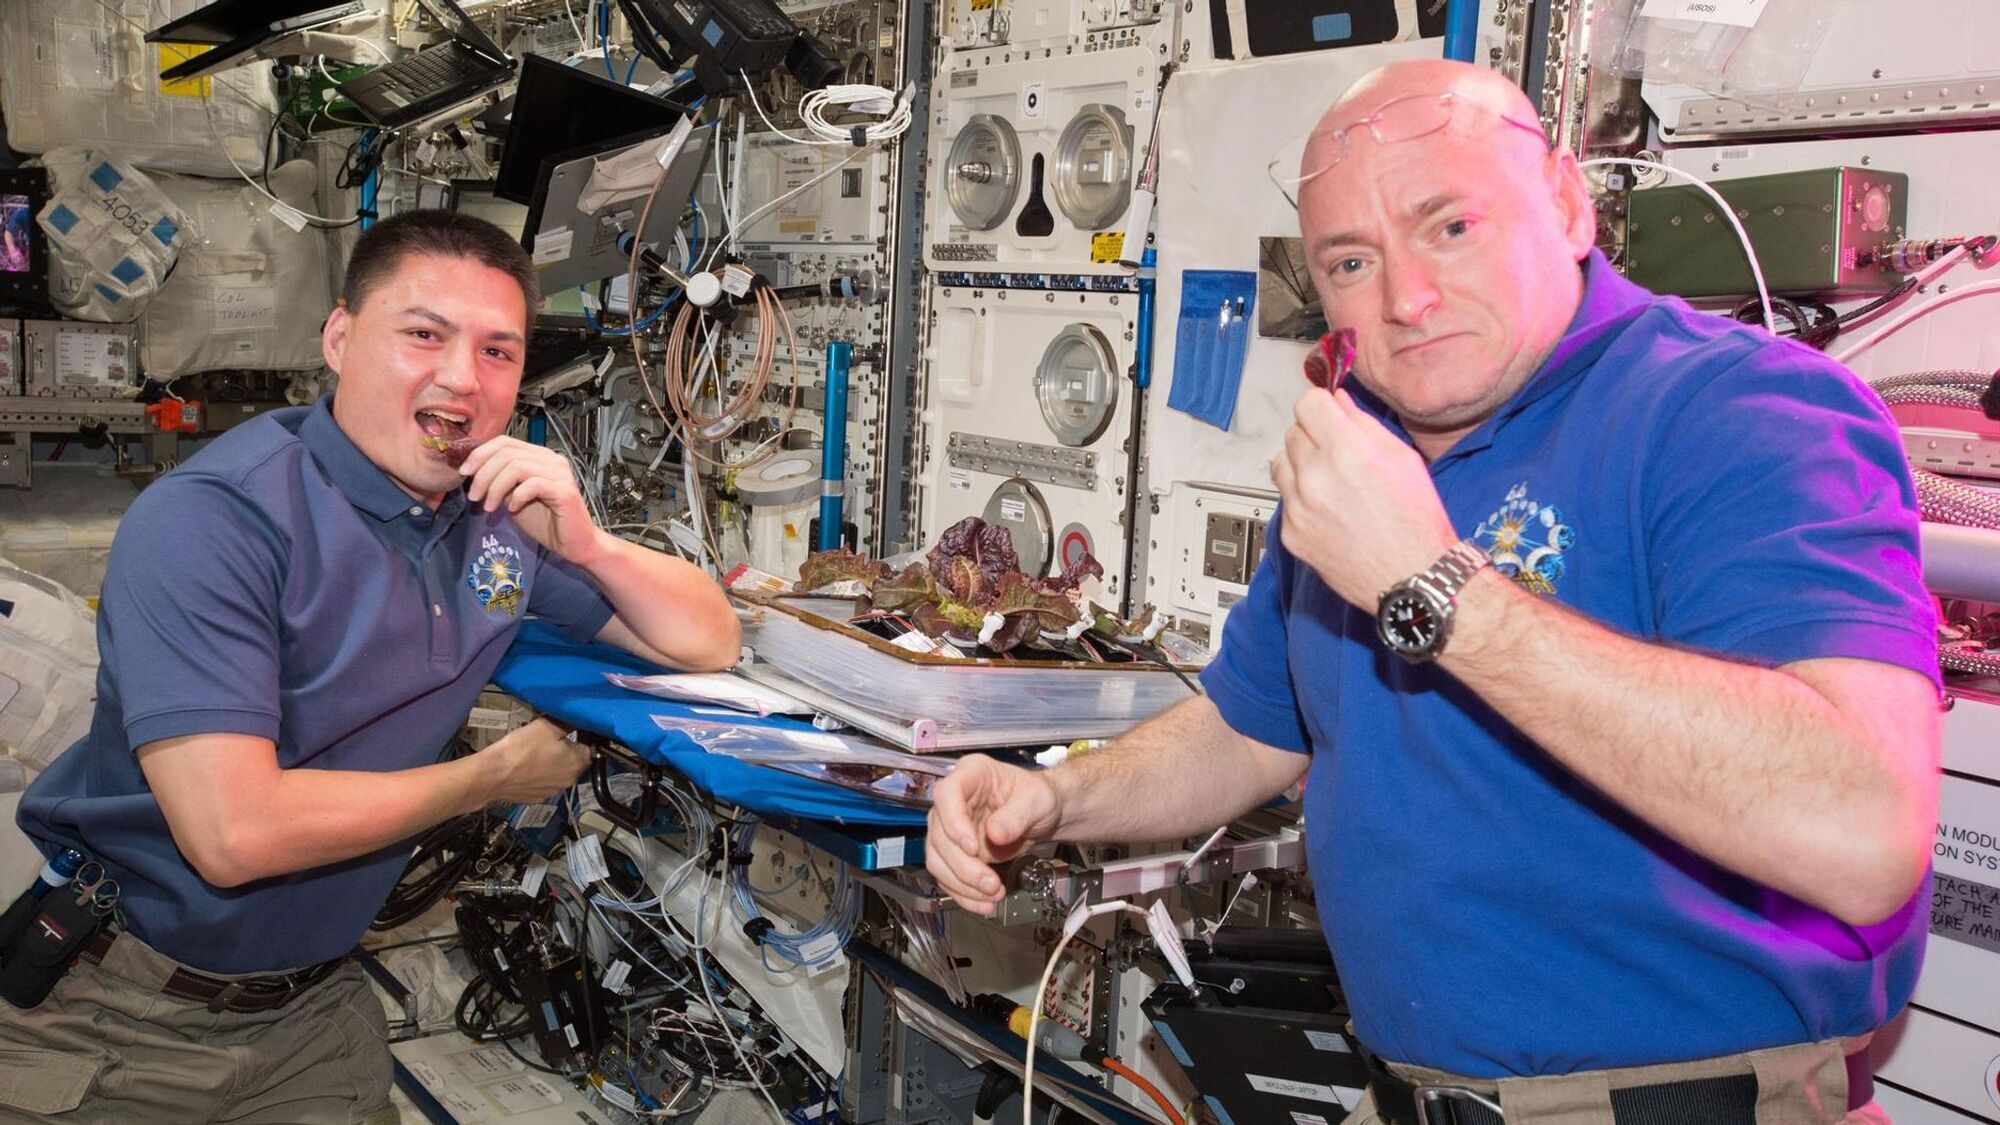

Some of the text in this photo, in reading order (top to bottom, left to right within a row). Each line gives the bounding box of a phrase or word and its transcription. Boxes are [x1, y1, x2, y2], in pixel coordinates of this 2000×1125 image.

[102, 197, 149, 236] 4053
[482, 534, 499, 550] 44
[1933, 842, 2000, 870] ON SYS
[1961, 898, 1993, 919] THE
